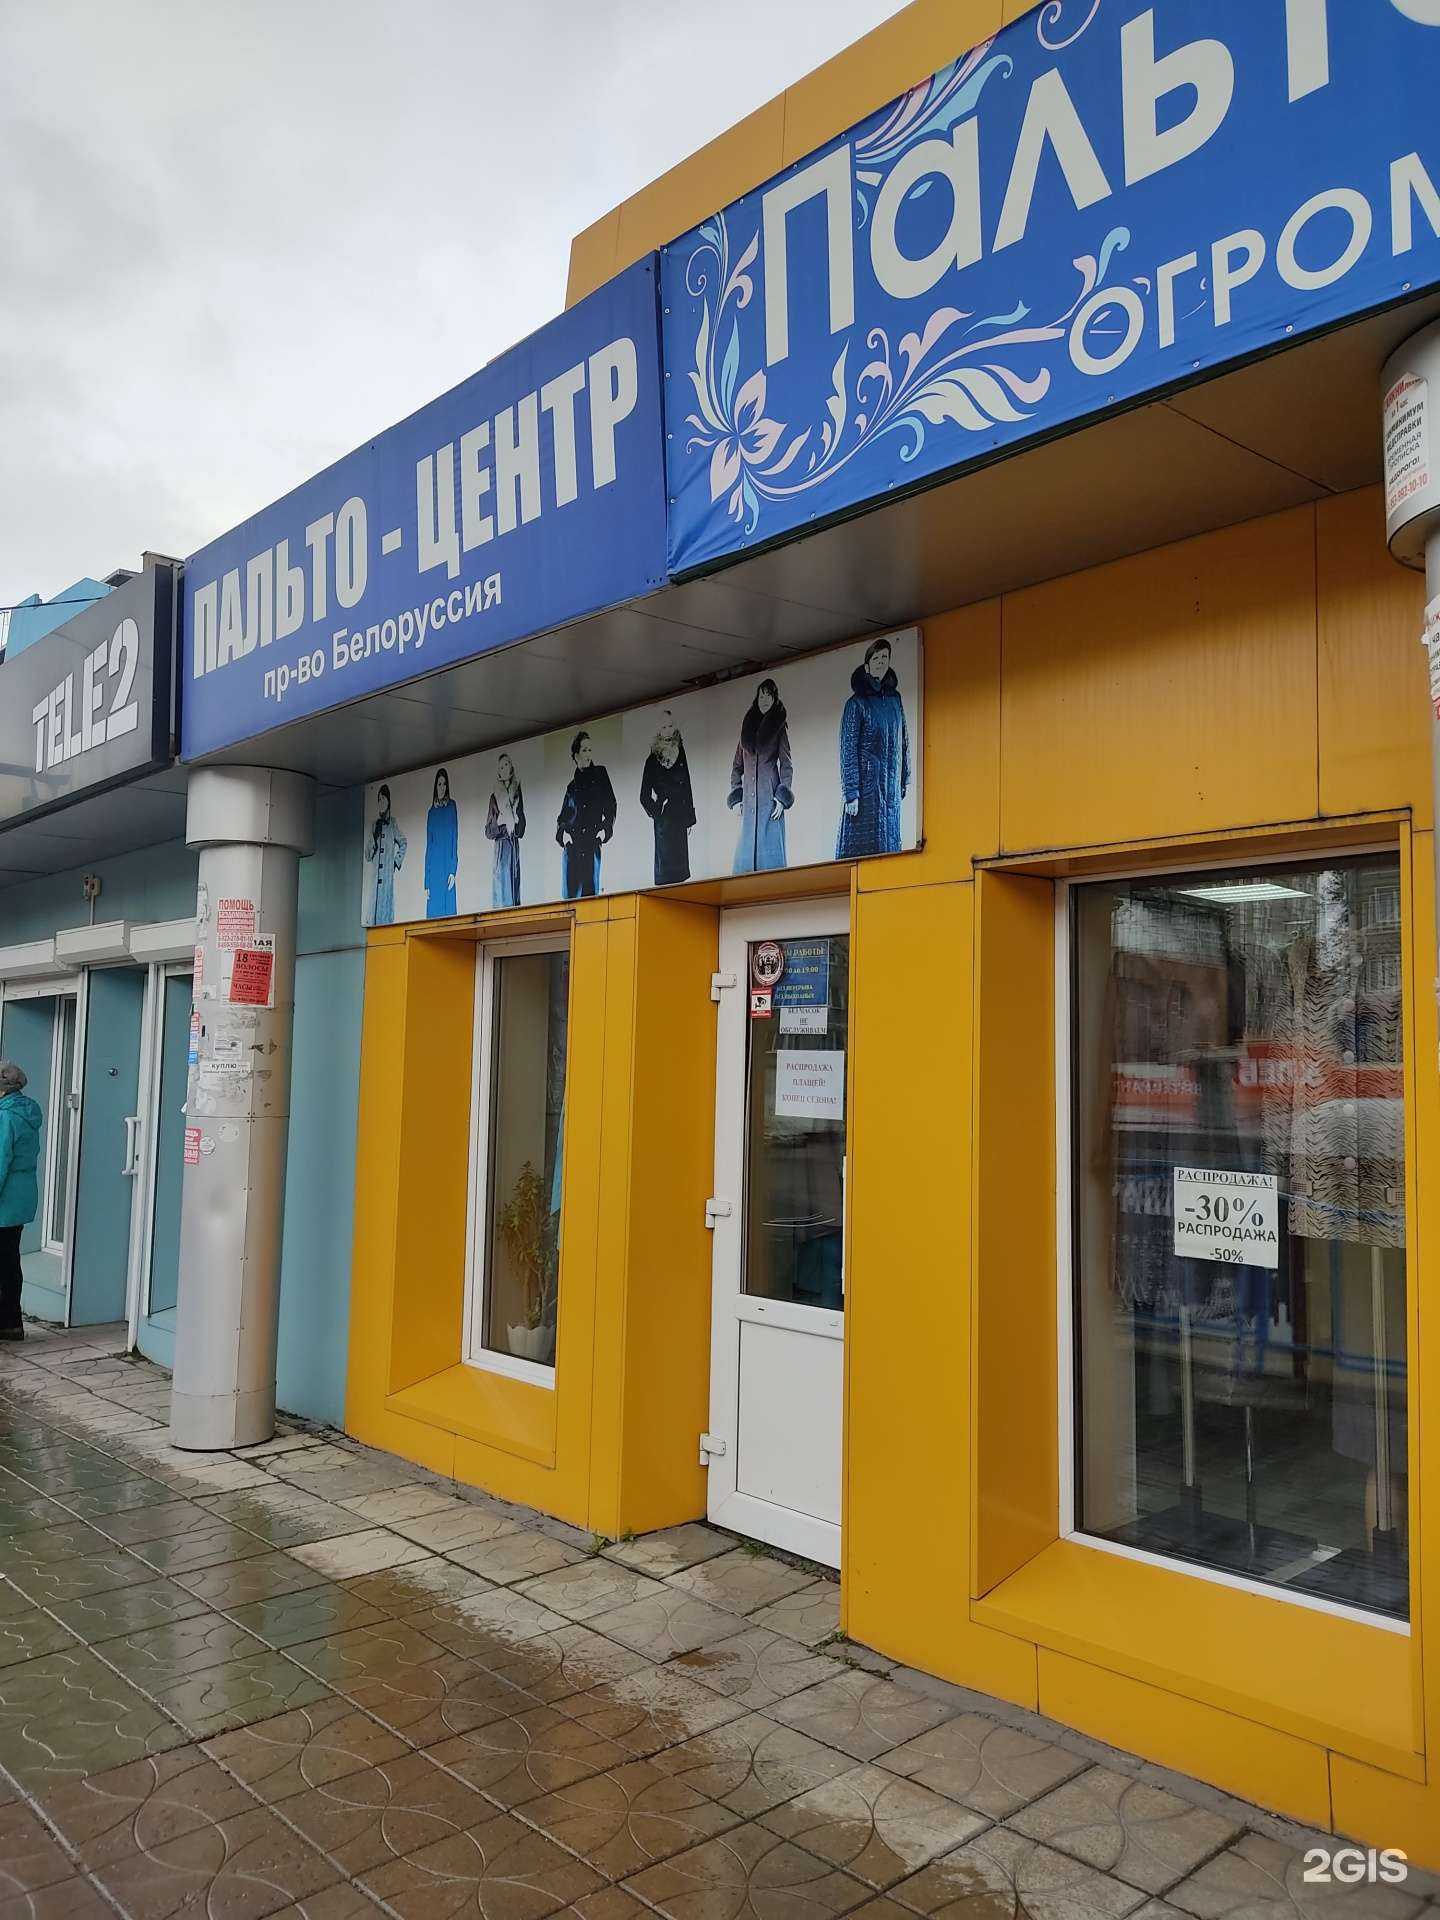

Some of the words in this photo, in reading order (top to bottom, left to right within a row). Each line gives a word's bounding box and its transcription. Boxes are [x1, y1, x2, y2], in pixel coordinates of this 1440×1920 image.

[193, 496, 368, 680] ПАЛЬТО
[416, 337, 638, 578] ЦЕНТР
[263, 656, 325, 702] пр-во
[333, 572, 502, 672] Белоруссия
[32, 618, 140, 774] TELE2
[218, 899, 254, 911] ПОМОЩЬ
[786, 1063, 833, 1072] РАСПРОДАЖА
[1178, 1170, 1273, 1187] РАСПРОДАЖА!
[1184, 1194, 1264, 1227] -30%
[1178, 1221, 1277, 1243] РАСПРОДАЖА
[1209, 1247, 1244, 1263] -50%
